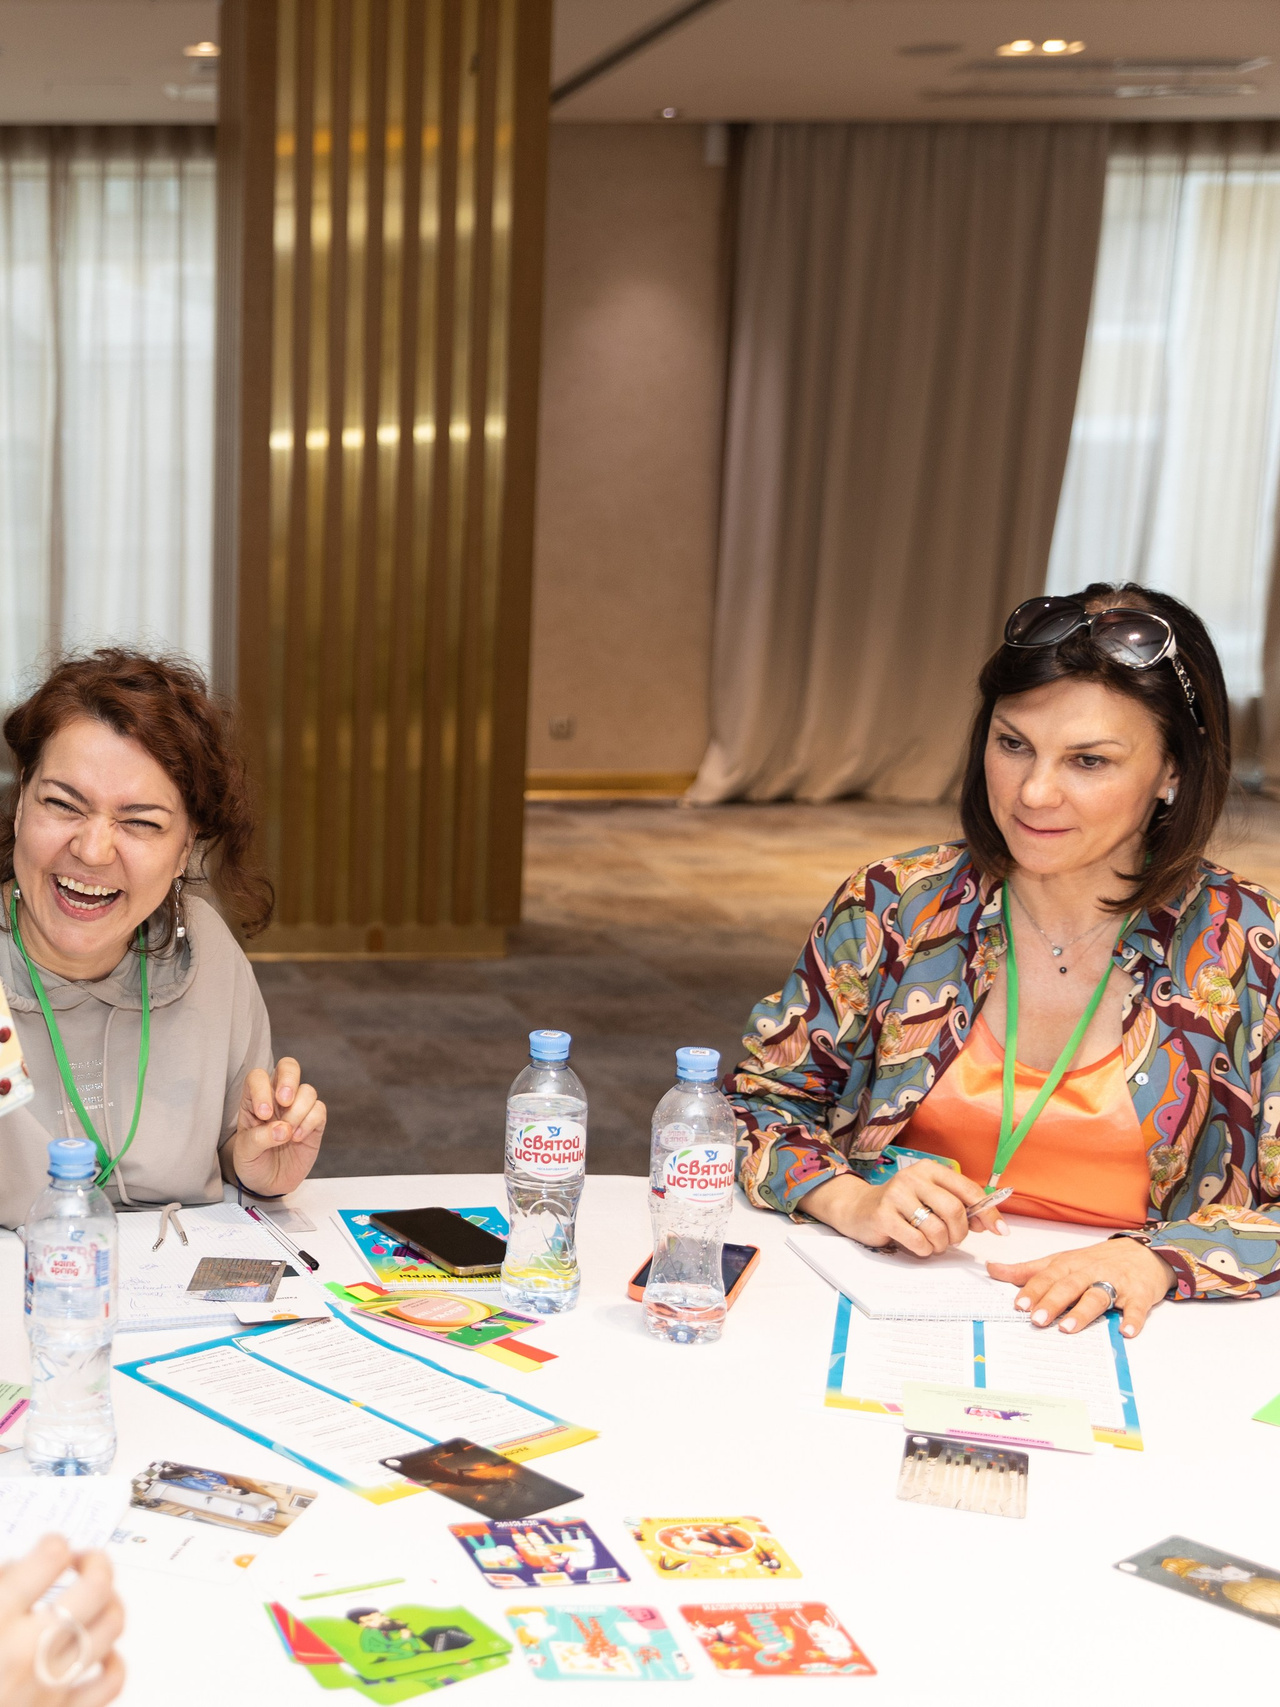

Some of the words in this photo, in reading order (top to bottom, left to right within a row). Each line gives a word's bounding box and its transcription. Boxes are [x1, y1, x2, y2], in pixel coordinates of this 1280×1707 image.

[523, 1135, 580, 1151] СВЯТОЙ
[515, 1147, 585, 1164] ИСТОЧНИК
[677, 1159, 734, 1176] СВЯТОЙ
[51, 1267, 78, 1277] spring
